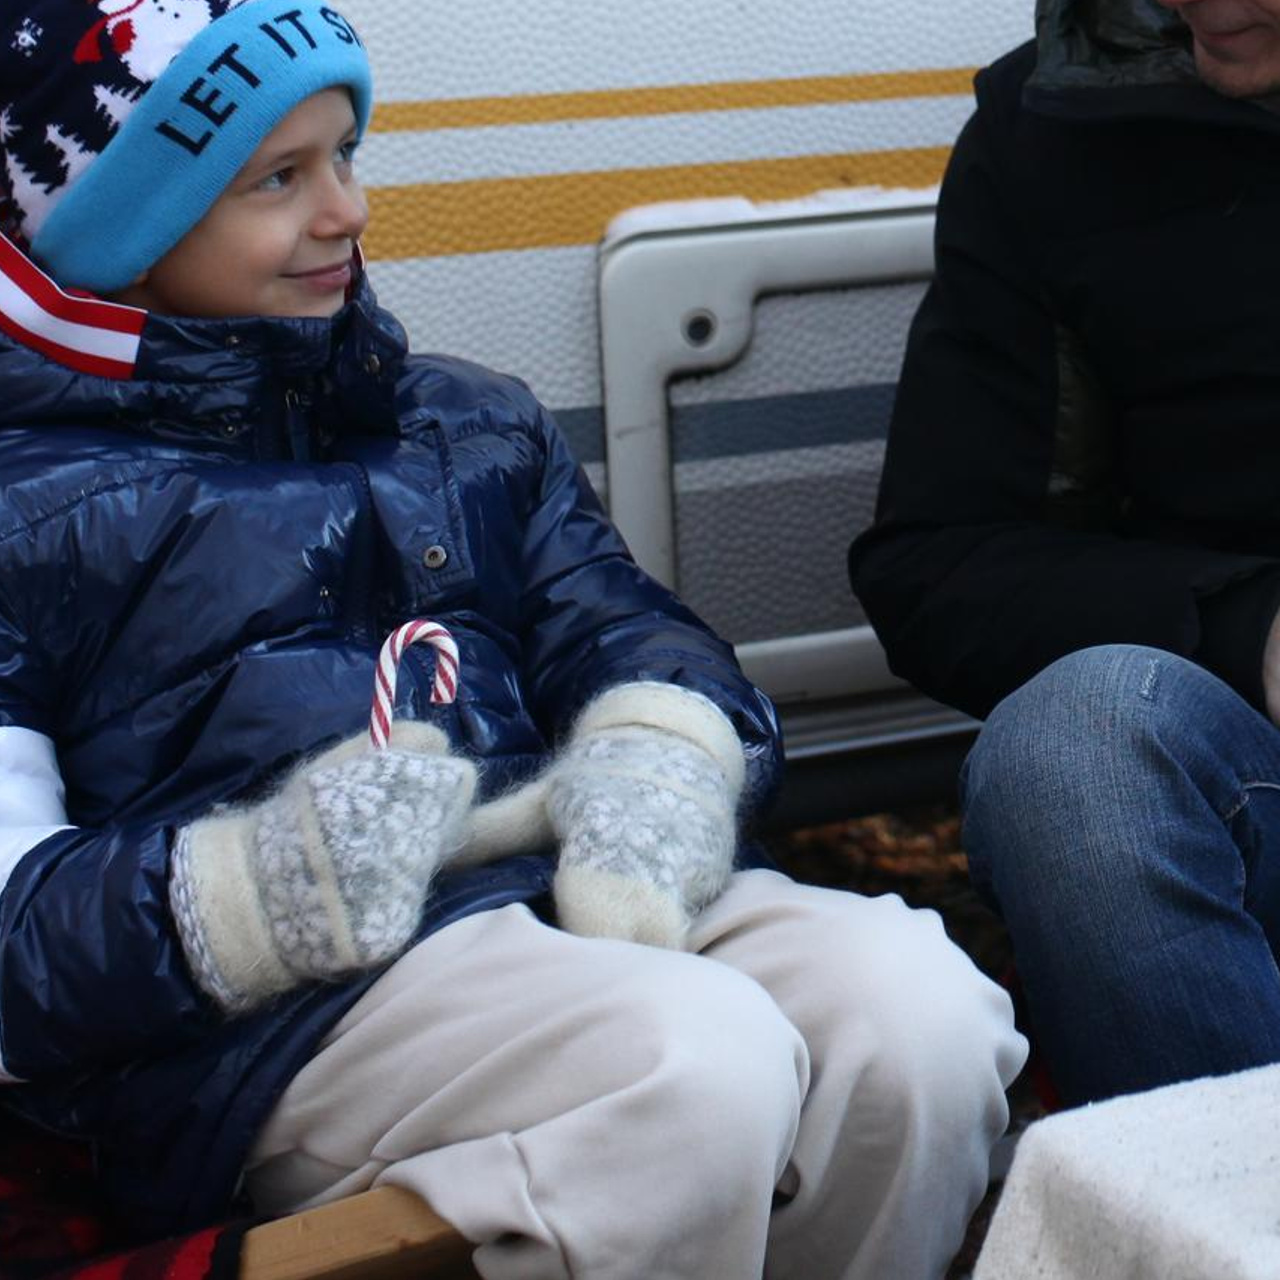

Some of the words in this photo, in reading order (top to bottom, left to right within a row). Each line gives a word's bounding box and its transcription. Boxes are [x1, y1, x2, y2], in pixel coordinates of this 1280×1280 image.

[154, 42, 262, 157] LET
[258, 9, 319, 61] IT
[319, 6, 366, 52] S
